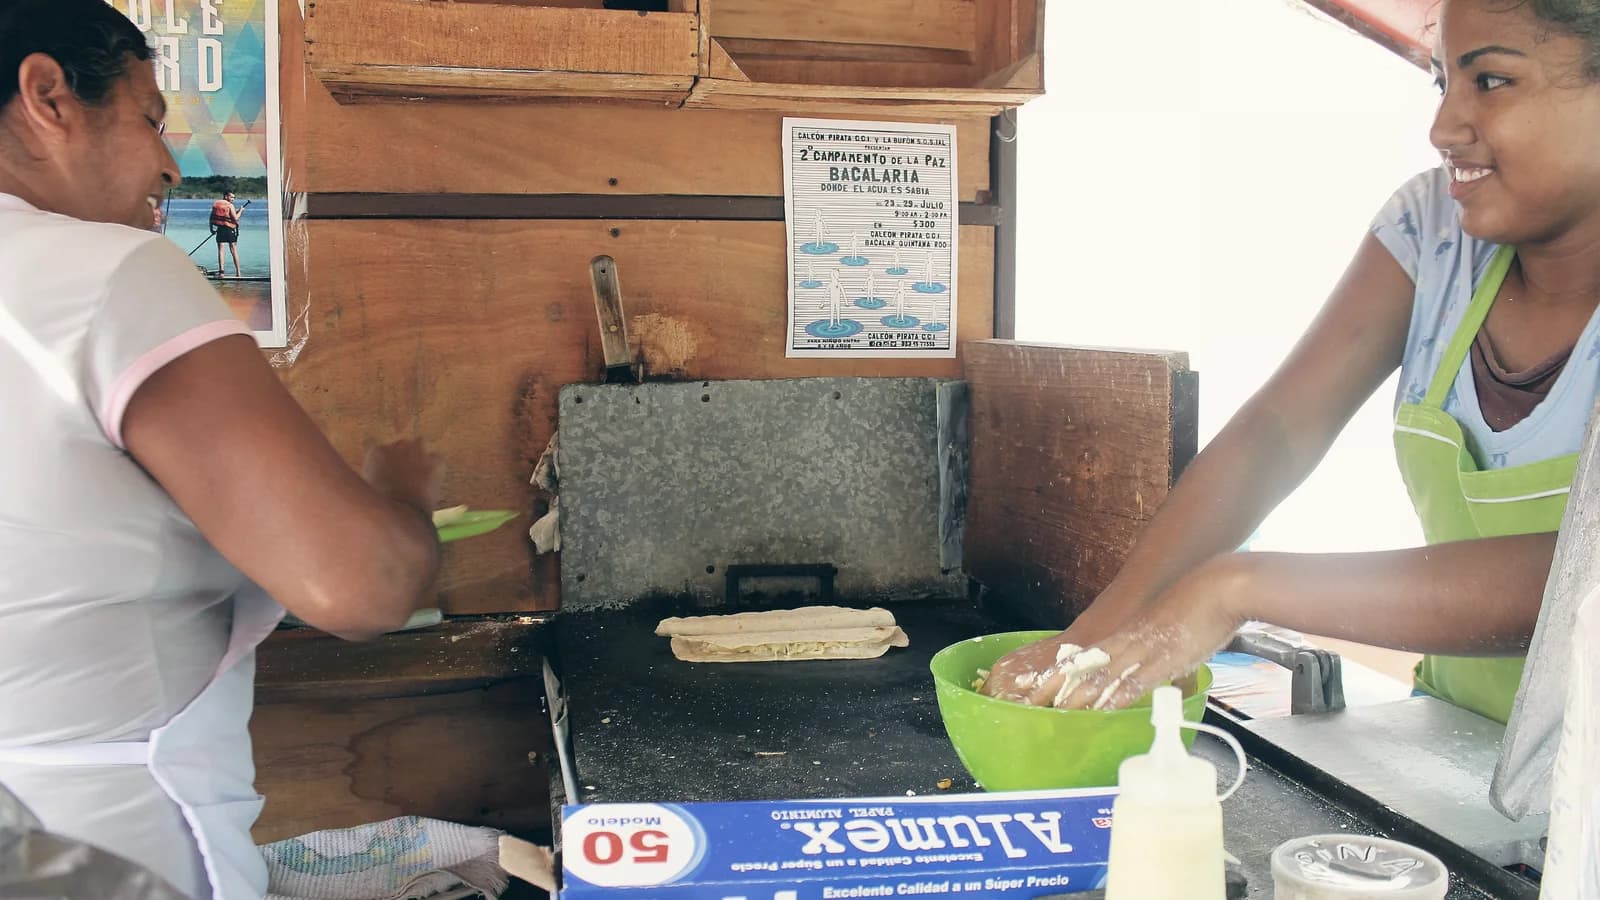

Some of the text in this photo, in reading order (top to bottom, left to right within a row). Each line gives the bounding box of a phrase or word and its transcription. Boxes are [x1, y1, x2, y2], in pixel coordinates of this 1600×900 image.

[154, 36, 224, 92] RD
[829, 133, 852, 141] PIRATA
[814, 150, 887, 165] CAMPAMENTO
[907, 156, 919, 164] LA
[829, 166, 919, 183] BACALARIA
[821, 183, 848, 192] DONDE
[853, 184, 864, 193] EL
[891, 186, 902, 194] ES
[905, 186, 930, 196] SABIA
[900, 231, 922, 239] PIRATA
[865, 239, 895, 247] BACALAR
[899, 240, 930, 248] QUINTANA
[896, 333, 919, 341] PIRATA
[771, 806, 895, 820] PAPEL ALUMINIO
[587, 815, 662, 826] Modelo
[582, 829, 671, 866] 50
[826, 858, 844, 868] un
[848, 859, 857, 867] a
[859, 856, 914, 868] Calidad
[915, 853, 984, 864] Excelente
[731, 860, 779, 872] Precio
[823, 874, 1070, 899] Excelente Calidad a un Súper Precio
